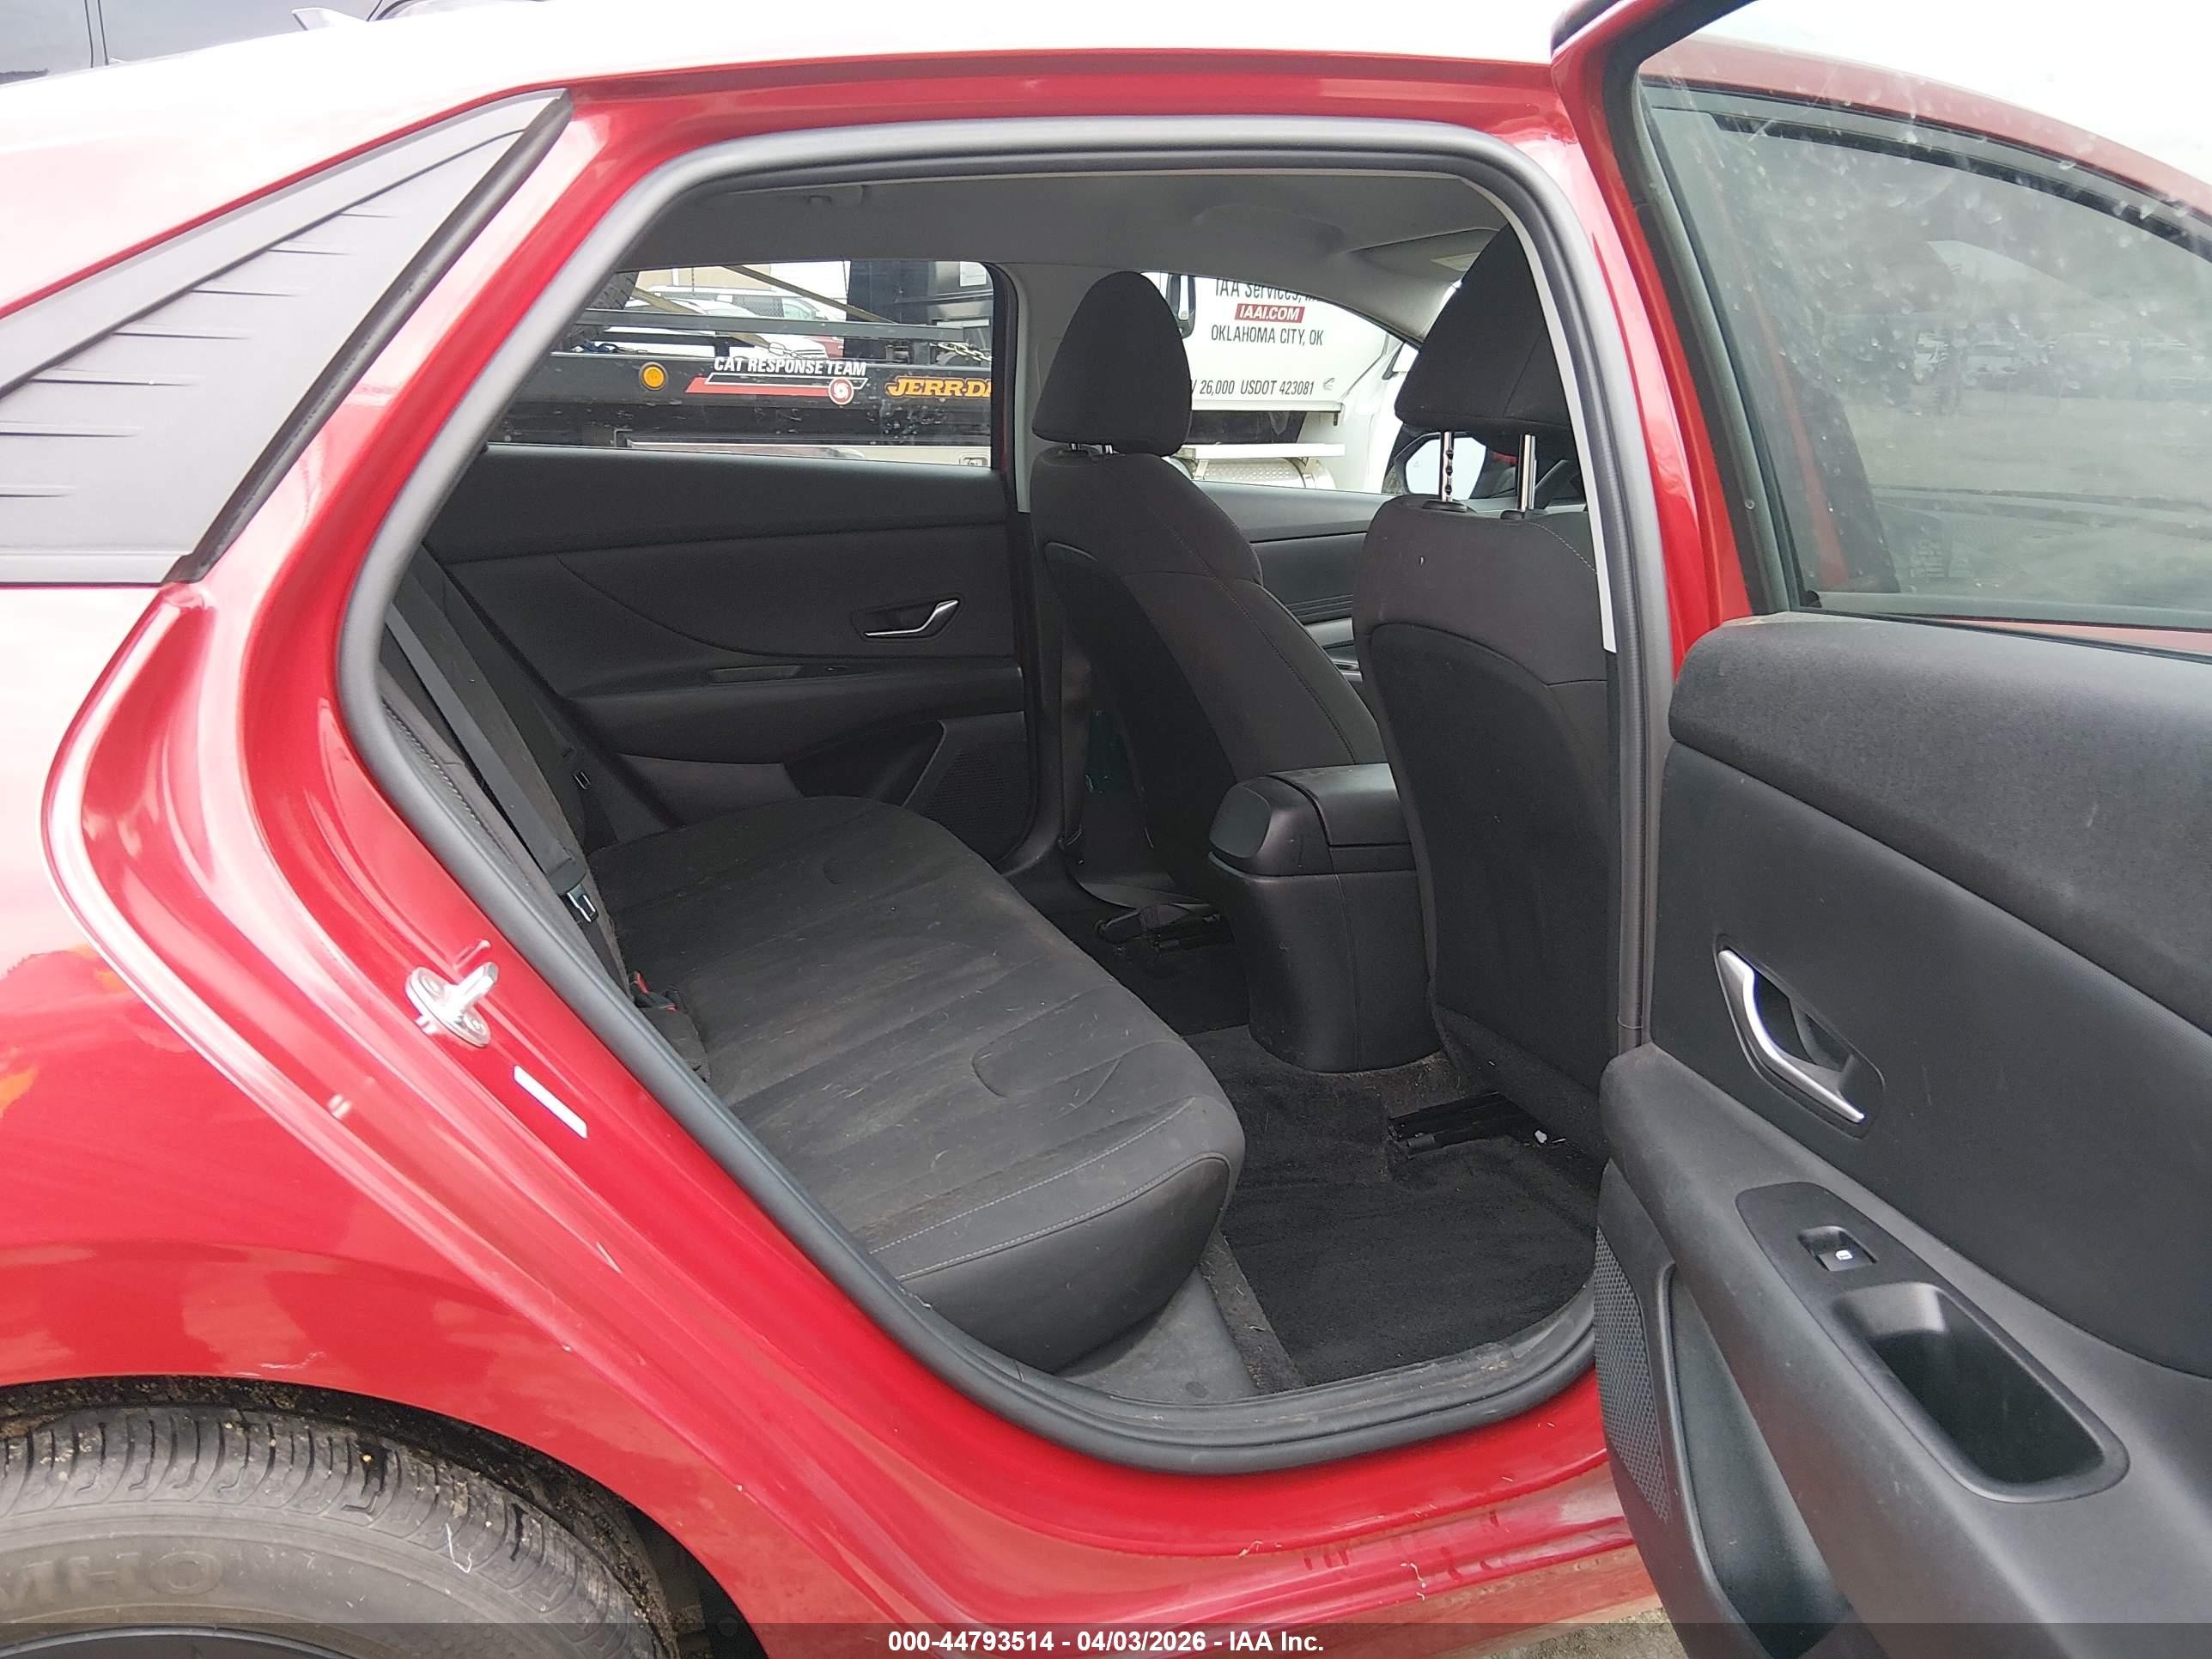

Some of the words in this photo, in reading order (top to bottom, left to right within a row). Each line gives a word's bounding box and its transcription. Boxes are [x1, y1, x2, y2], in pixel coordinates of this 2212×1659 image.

[1215, 278, 1240, 296] IAA
[1239, 305, 1300, 321] IAAI.COM
[1211, 325, 1276, 343] OKLAHOMA
[1279, 328, 1305, 346] CITY,
[1310, 330, 1324, 345] OK
[714, 356, 748, 372] CAT
[747, 357, 824, 375] RESPONSE
[824, 360, 866, 376] TEAM
[1200, 380, 1235, 396] 26,000
[1240, 380, 1277, 395] USDOT
[1279, 380, 1315, 395] 423081
